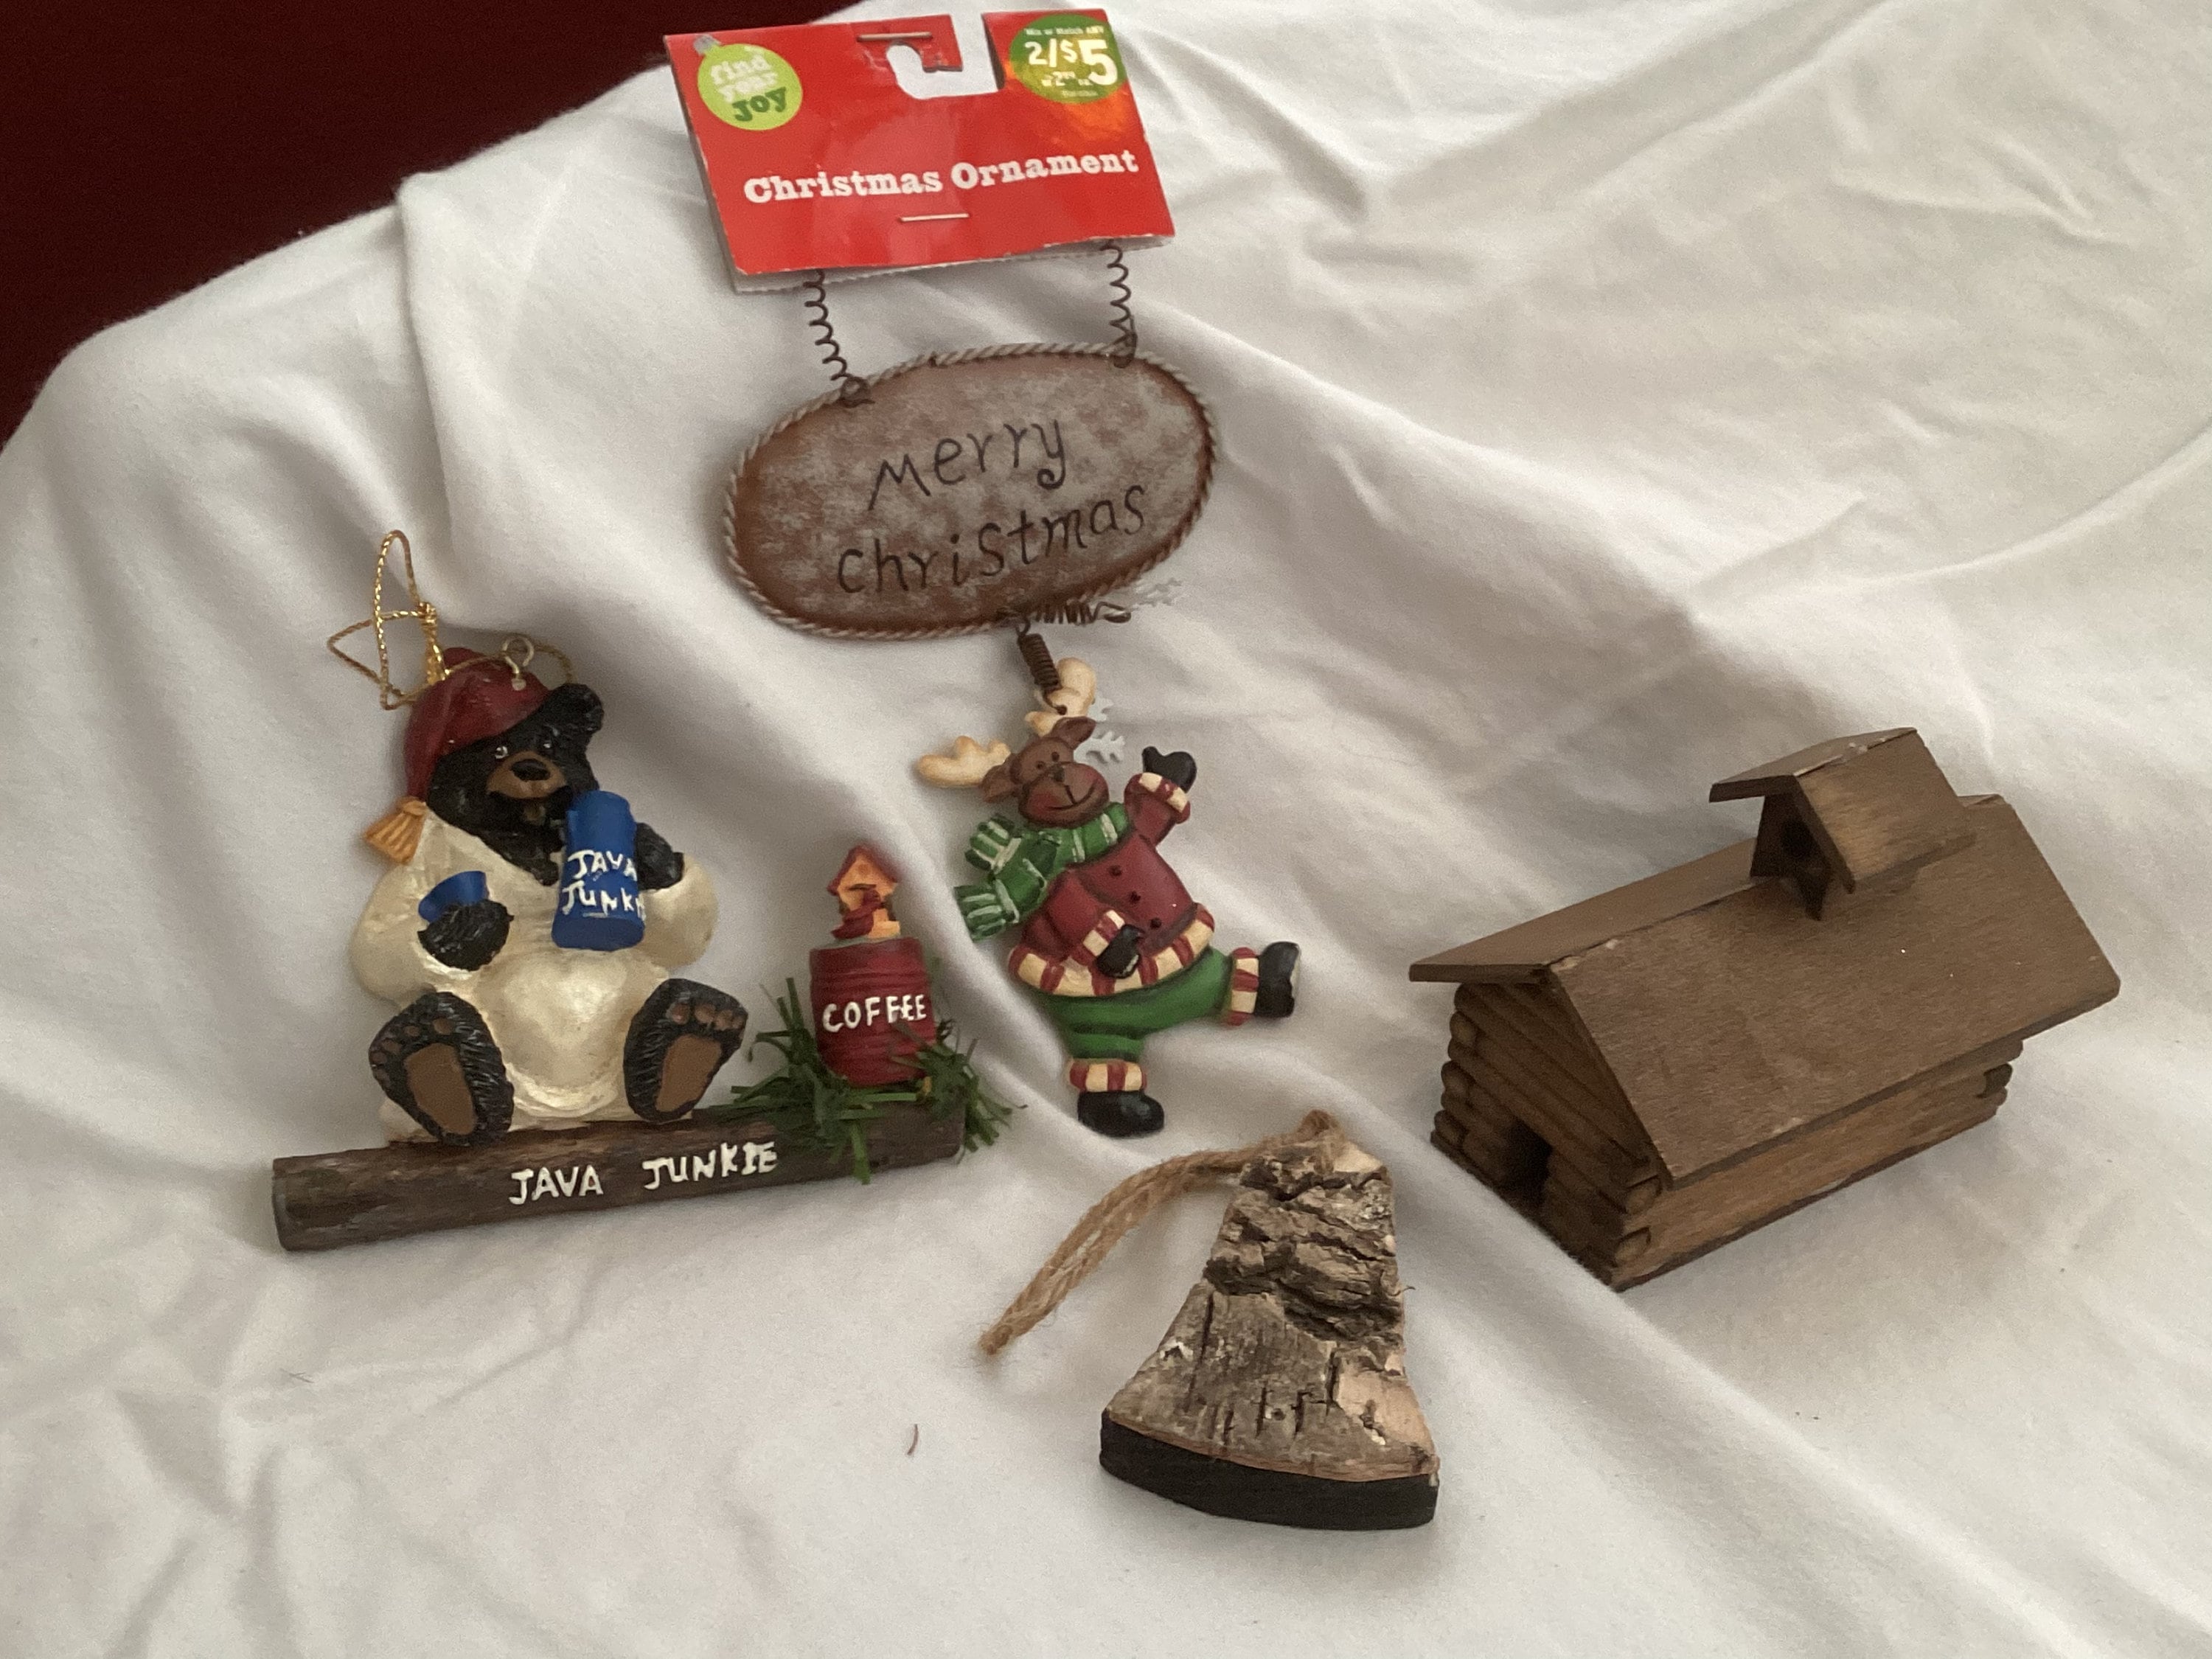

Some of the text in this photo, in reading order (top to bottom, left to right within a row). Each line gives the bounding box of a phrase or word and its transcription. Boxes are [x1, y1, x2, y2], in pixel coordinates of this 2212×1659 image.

[744, 150, 1139, 204] Christmas Ornament
[568, 850, 638, 881] JAVA
[823, 994, 928, 1032] COFFEE
[509, 1141, 779, 1205] JAVA JUNKIE
